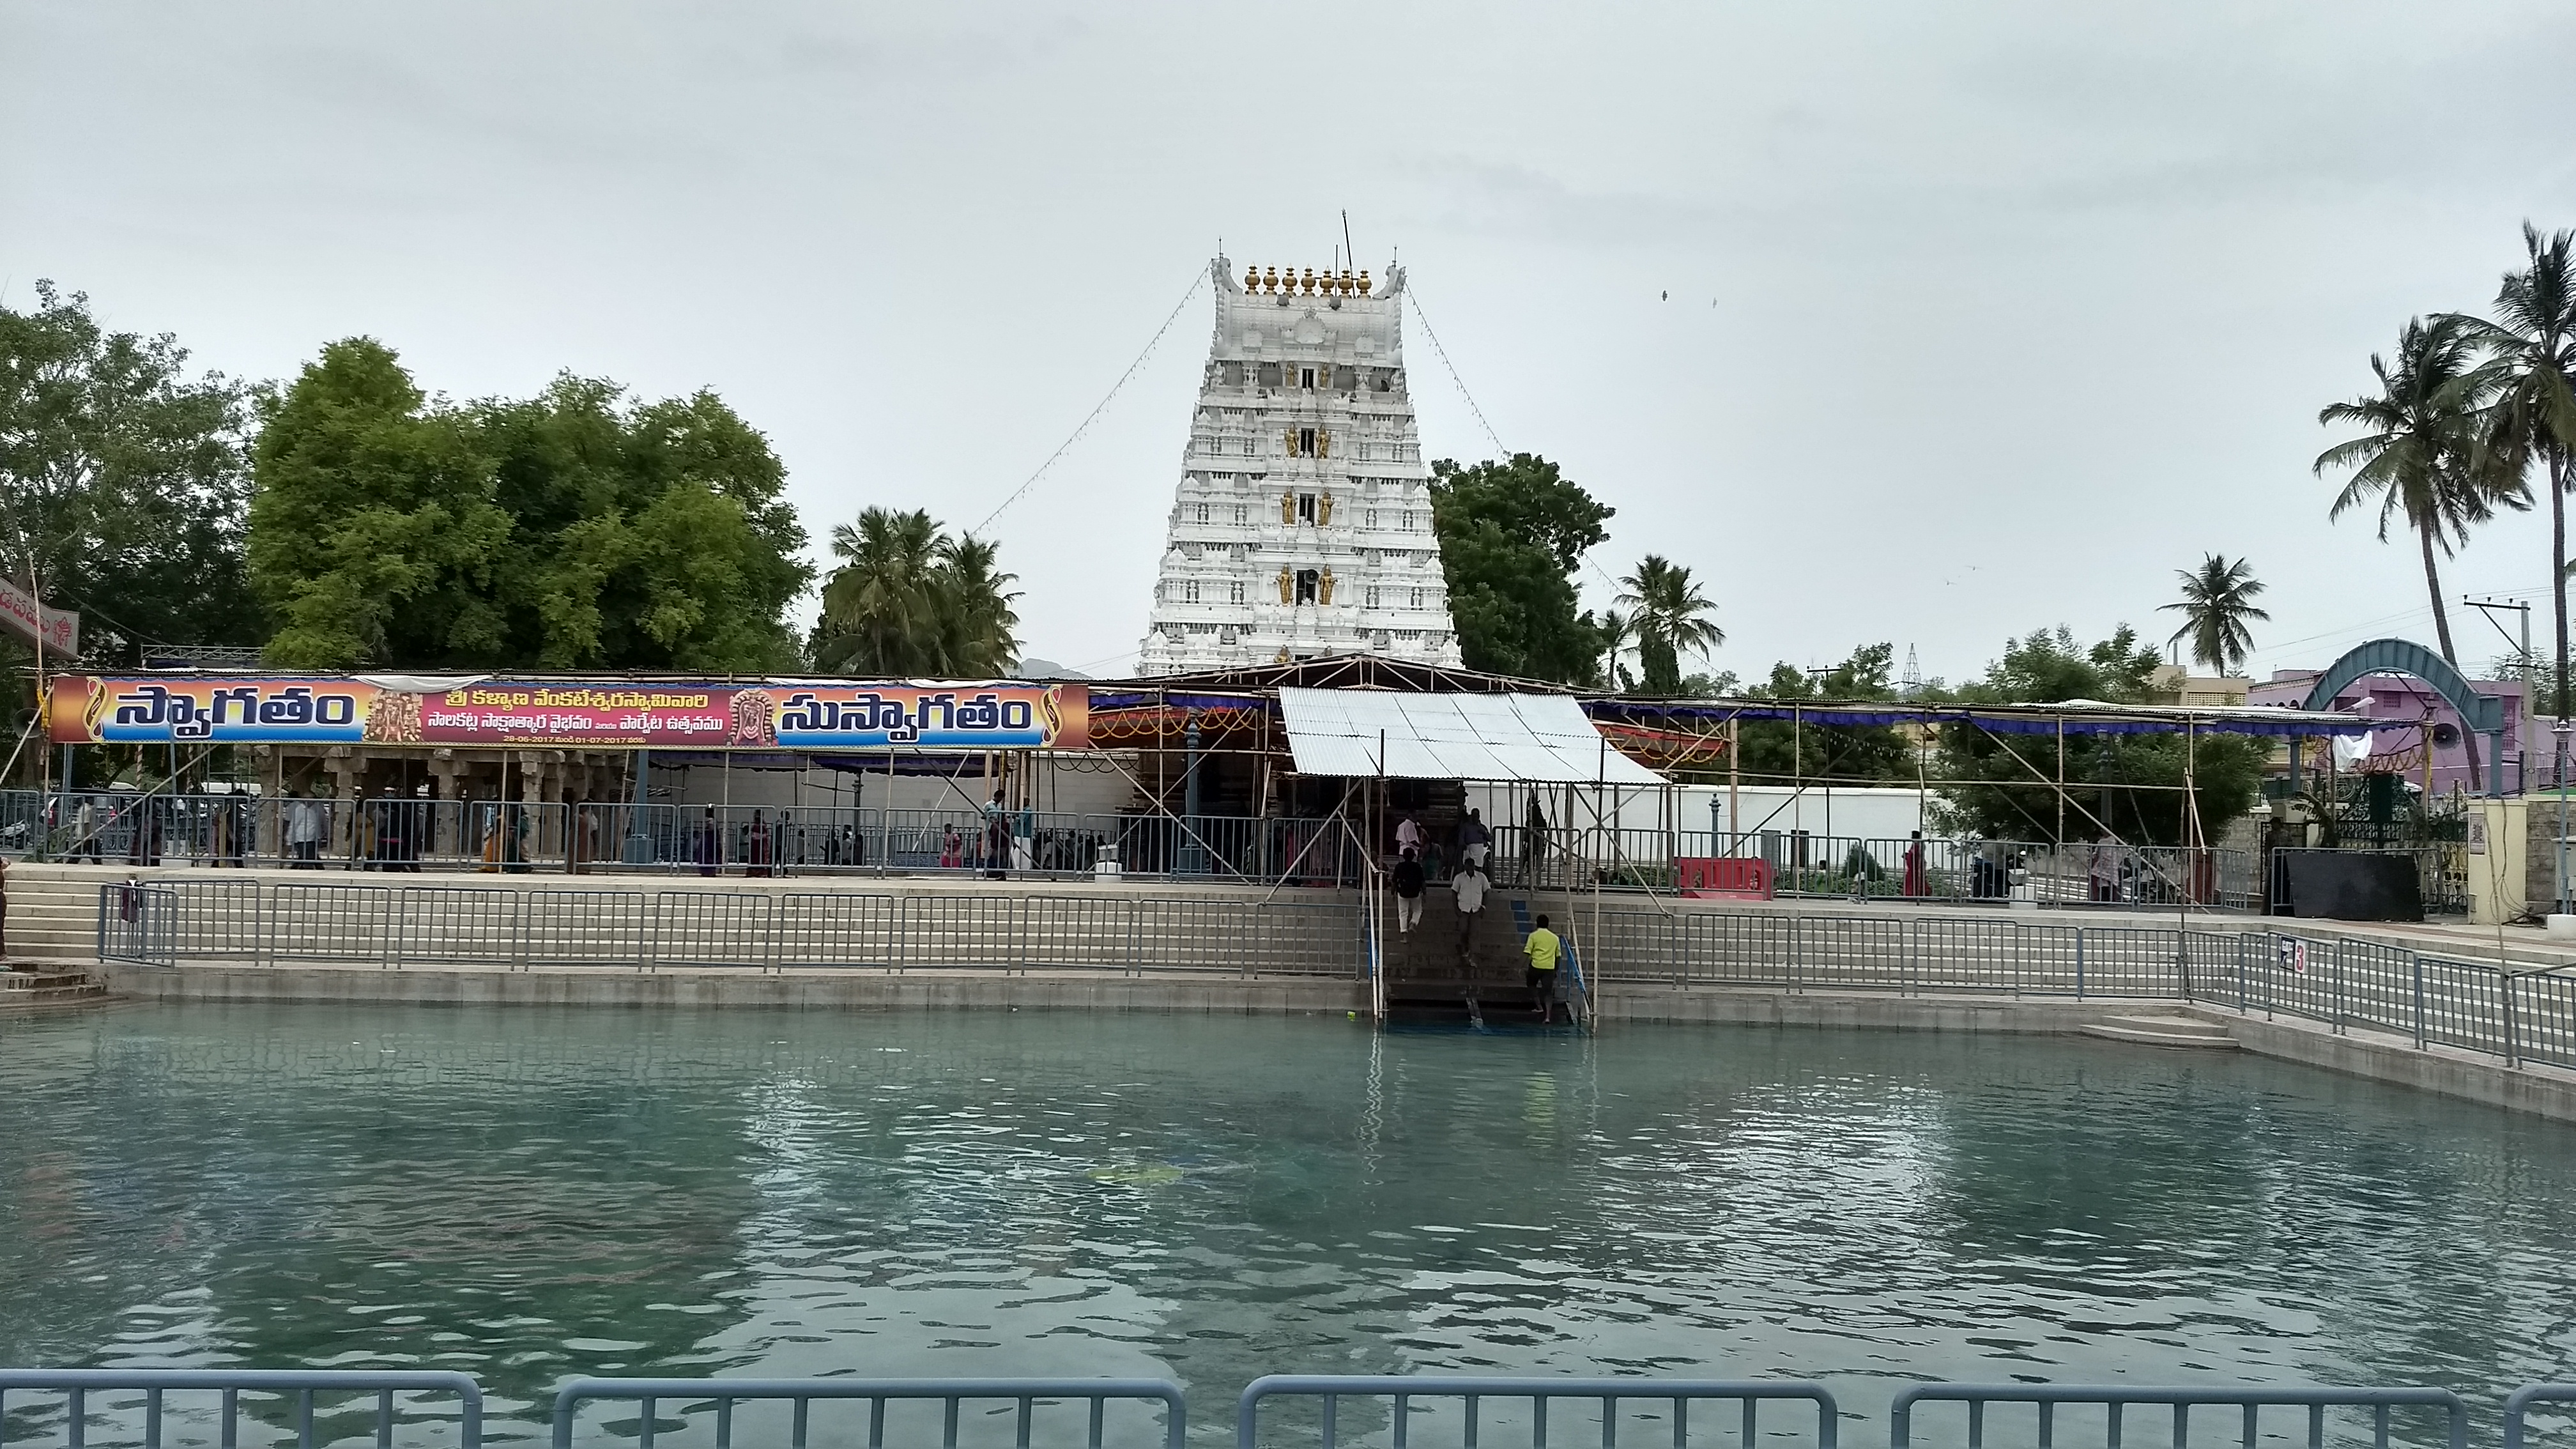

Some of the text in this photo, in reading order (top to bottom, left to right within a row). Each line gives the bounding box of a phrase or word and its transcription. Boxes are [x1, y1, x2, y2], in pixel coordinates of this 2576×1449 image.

[114, 684, 356, 738] స్వాగతం
[472, 689, 528, 711] కళ్యాణ
[534, 689, 709, 712] వేంకటేశ్వరస్వామివారి
[781, 693, 1032, 742] సుస్వాగతం
[428, 712, 478, 732] సాలకట్ల
[481, 712, 546, 733] సాక్షాత్కార
[550, 714, 592, 733] వైభవం
[620, 712, 662, 734] పార్వేట
[666, 715, 723, 735] ఉత్సవము
